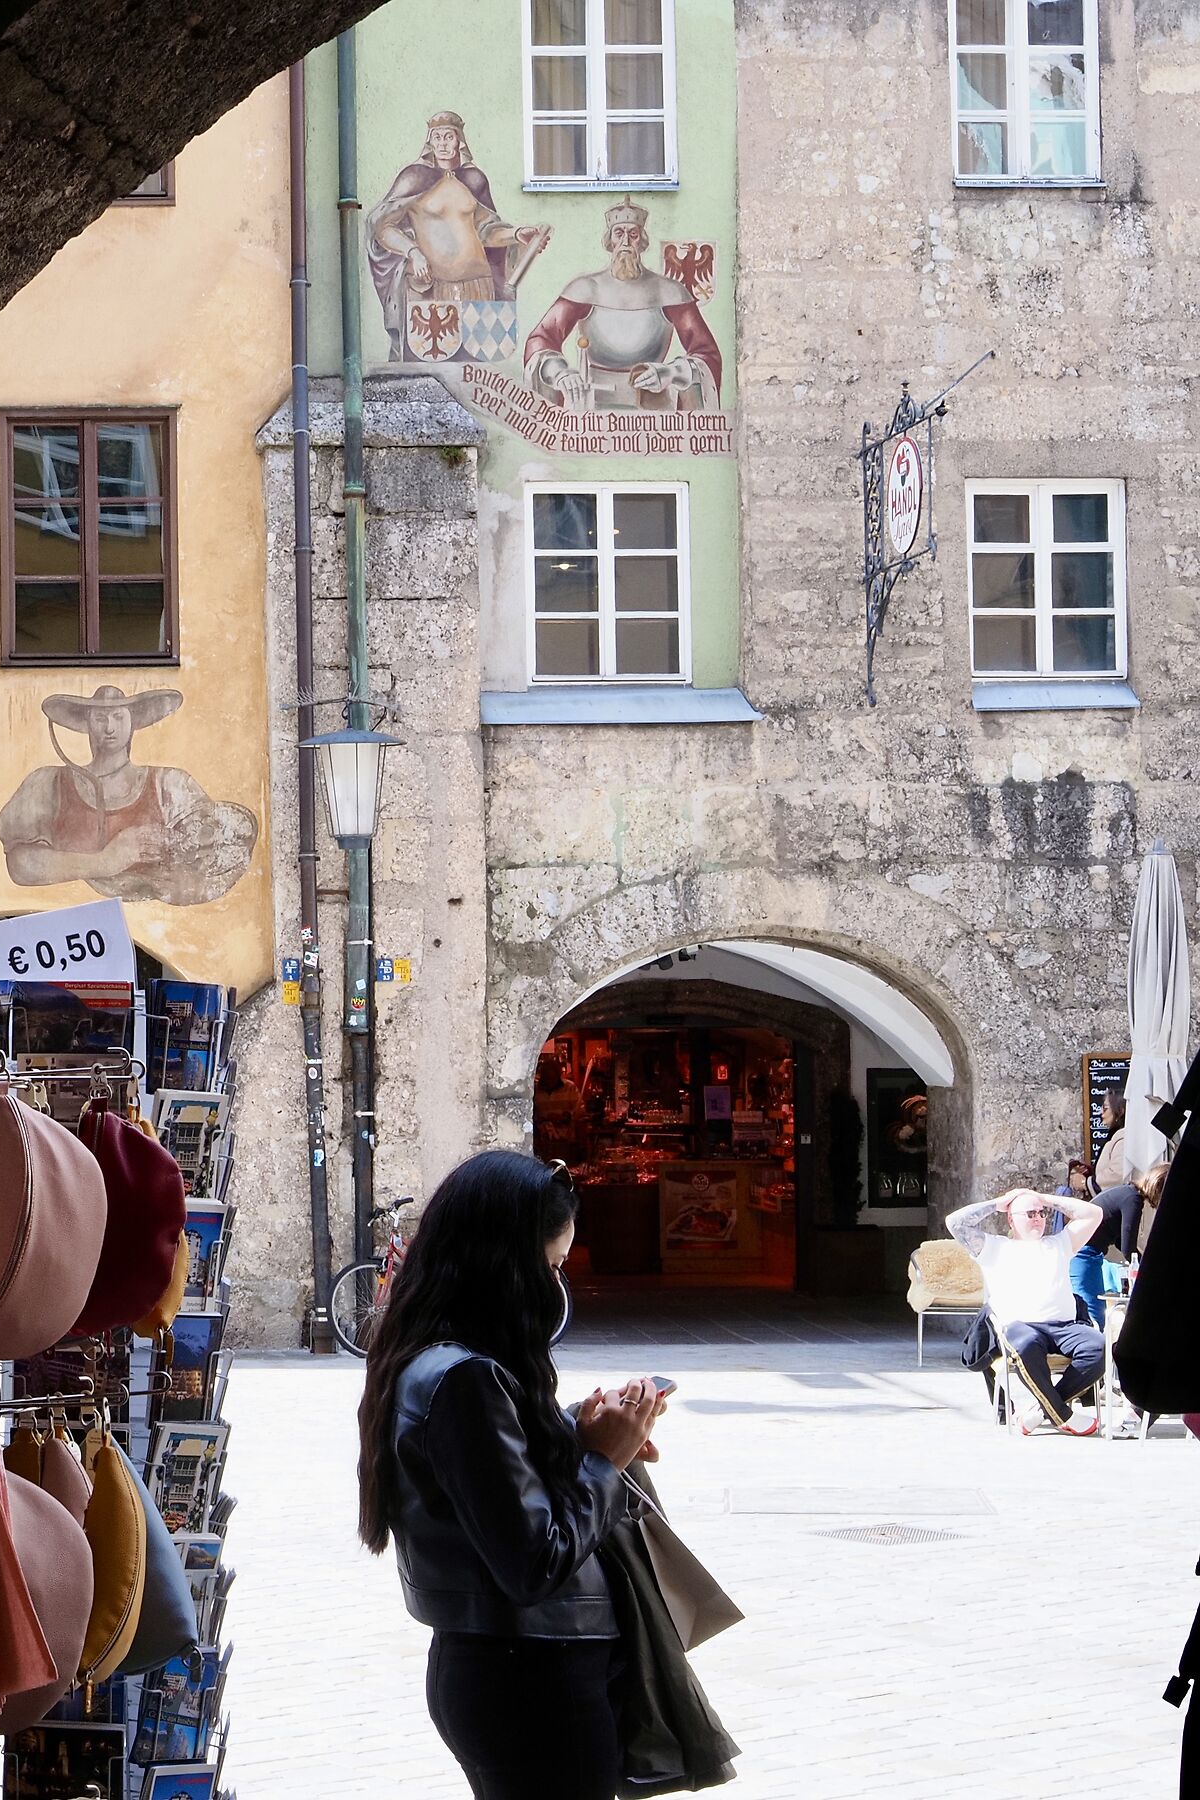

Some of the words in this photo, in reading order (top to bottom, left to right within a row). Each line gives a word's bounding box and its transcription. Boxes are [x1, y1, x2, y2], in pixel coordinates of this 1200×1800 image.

[462, 364, 513, 395] Beutel
[507, 384, 535, 411] und
[581, 410, 603, 434] für
[607, 411, 658, 432] Bauern
[660, 410, 685, 431] und
[504, 408, 537, 440] mag
[560, 433, 610, 455] keiner,
[611, 432, 641, 452] voll
[645, 433, 685, 456] jeder
[689, 433, 732, 456] gern!
[891, 479, 917, 522] HANDL
[36, 929, 106, 972] 0,50
